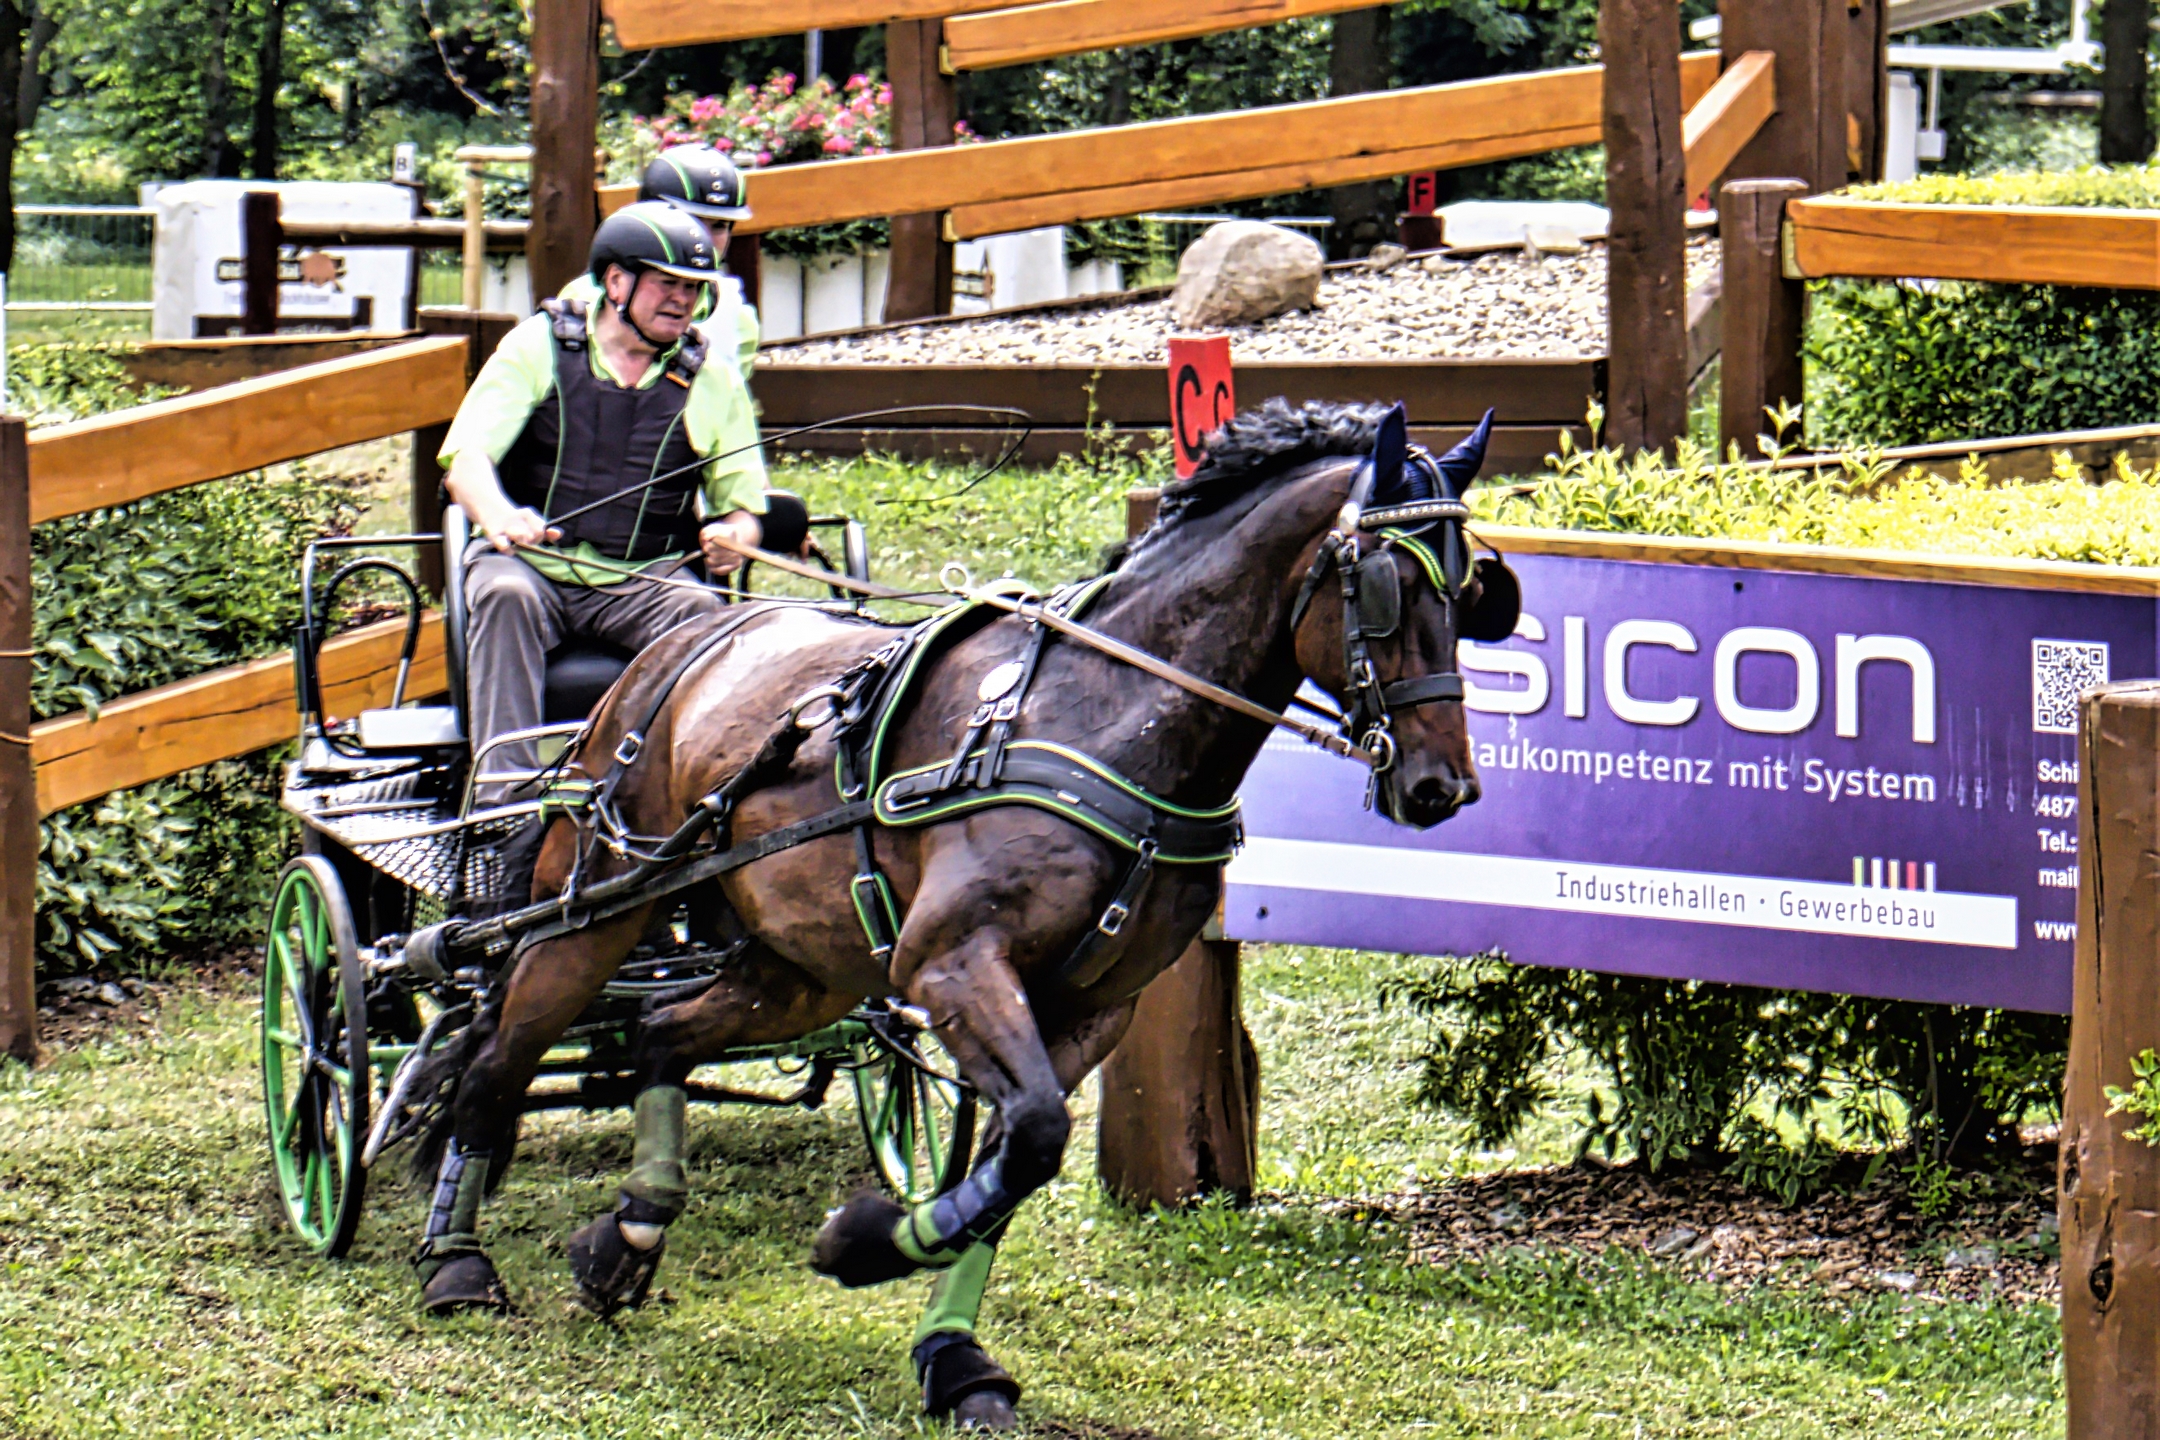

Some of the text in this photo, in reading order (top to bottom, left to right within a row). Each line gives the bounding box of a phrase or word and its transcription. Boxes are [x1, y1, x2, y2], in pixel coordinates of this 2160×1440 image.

[1414, 177, 1430, 207] F
[1176, 364, 1204, 462] C
[1728, 756, 1789, 791] mit
[1803, 759, 1936, 802] System
[1556, 871, 1936, 929] Industriehallen Gewerbebau
